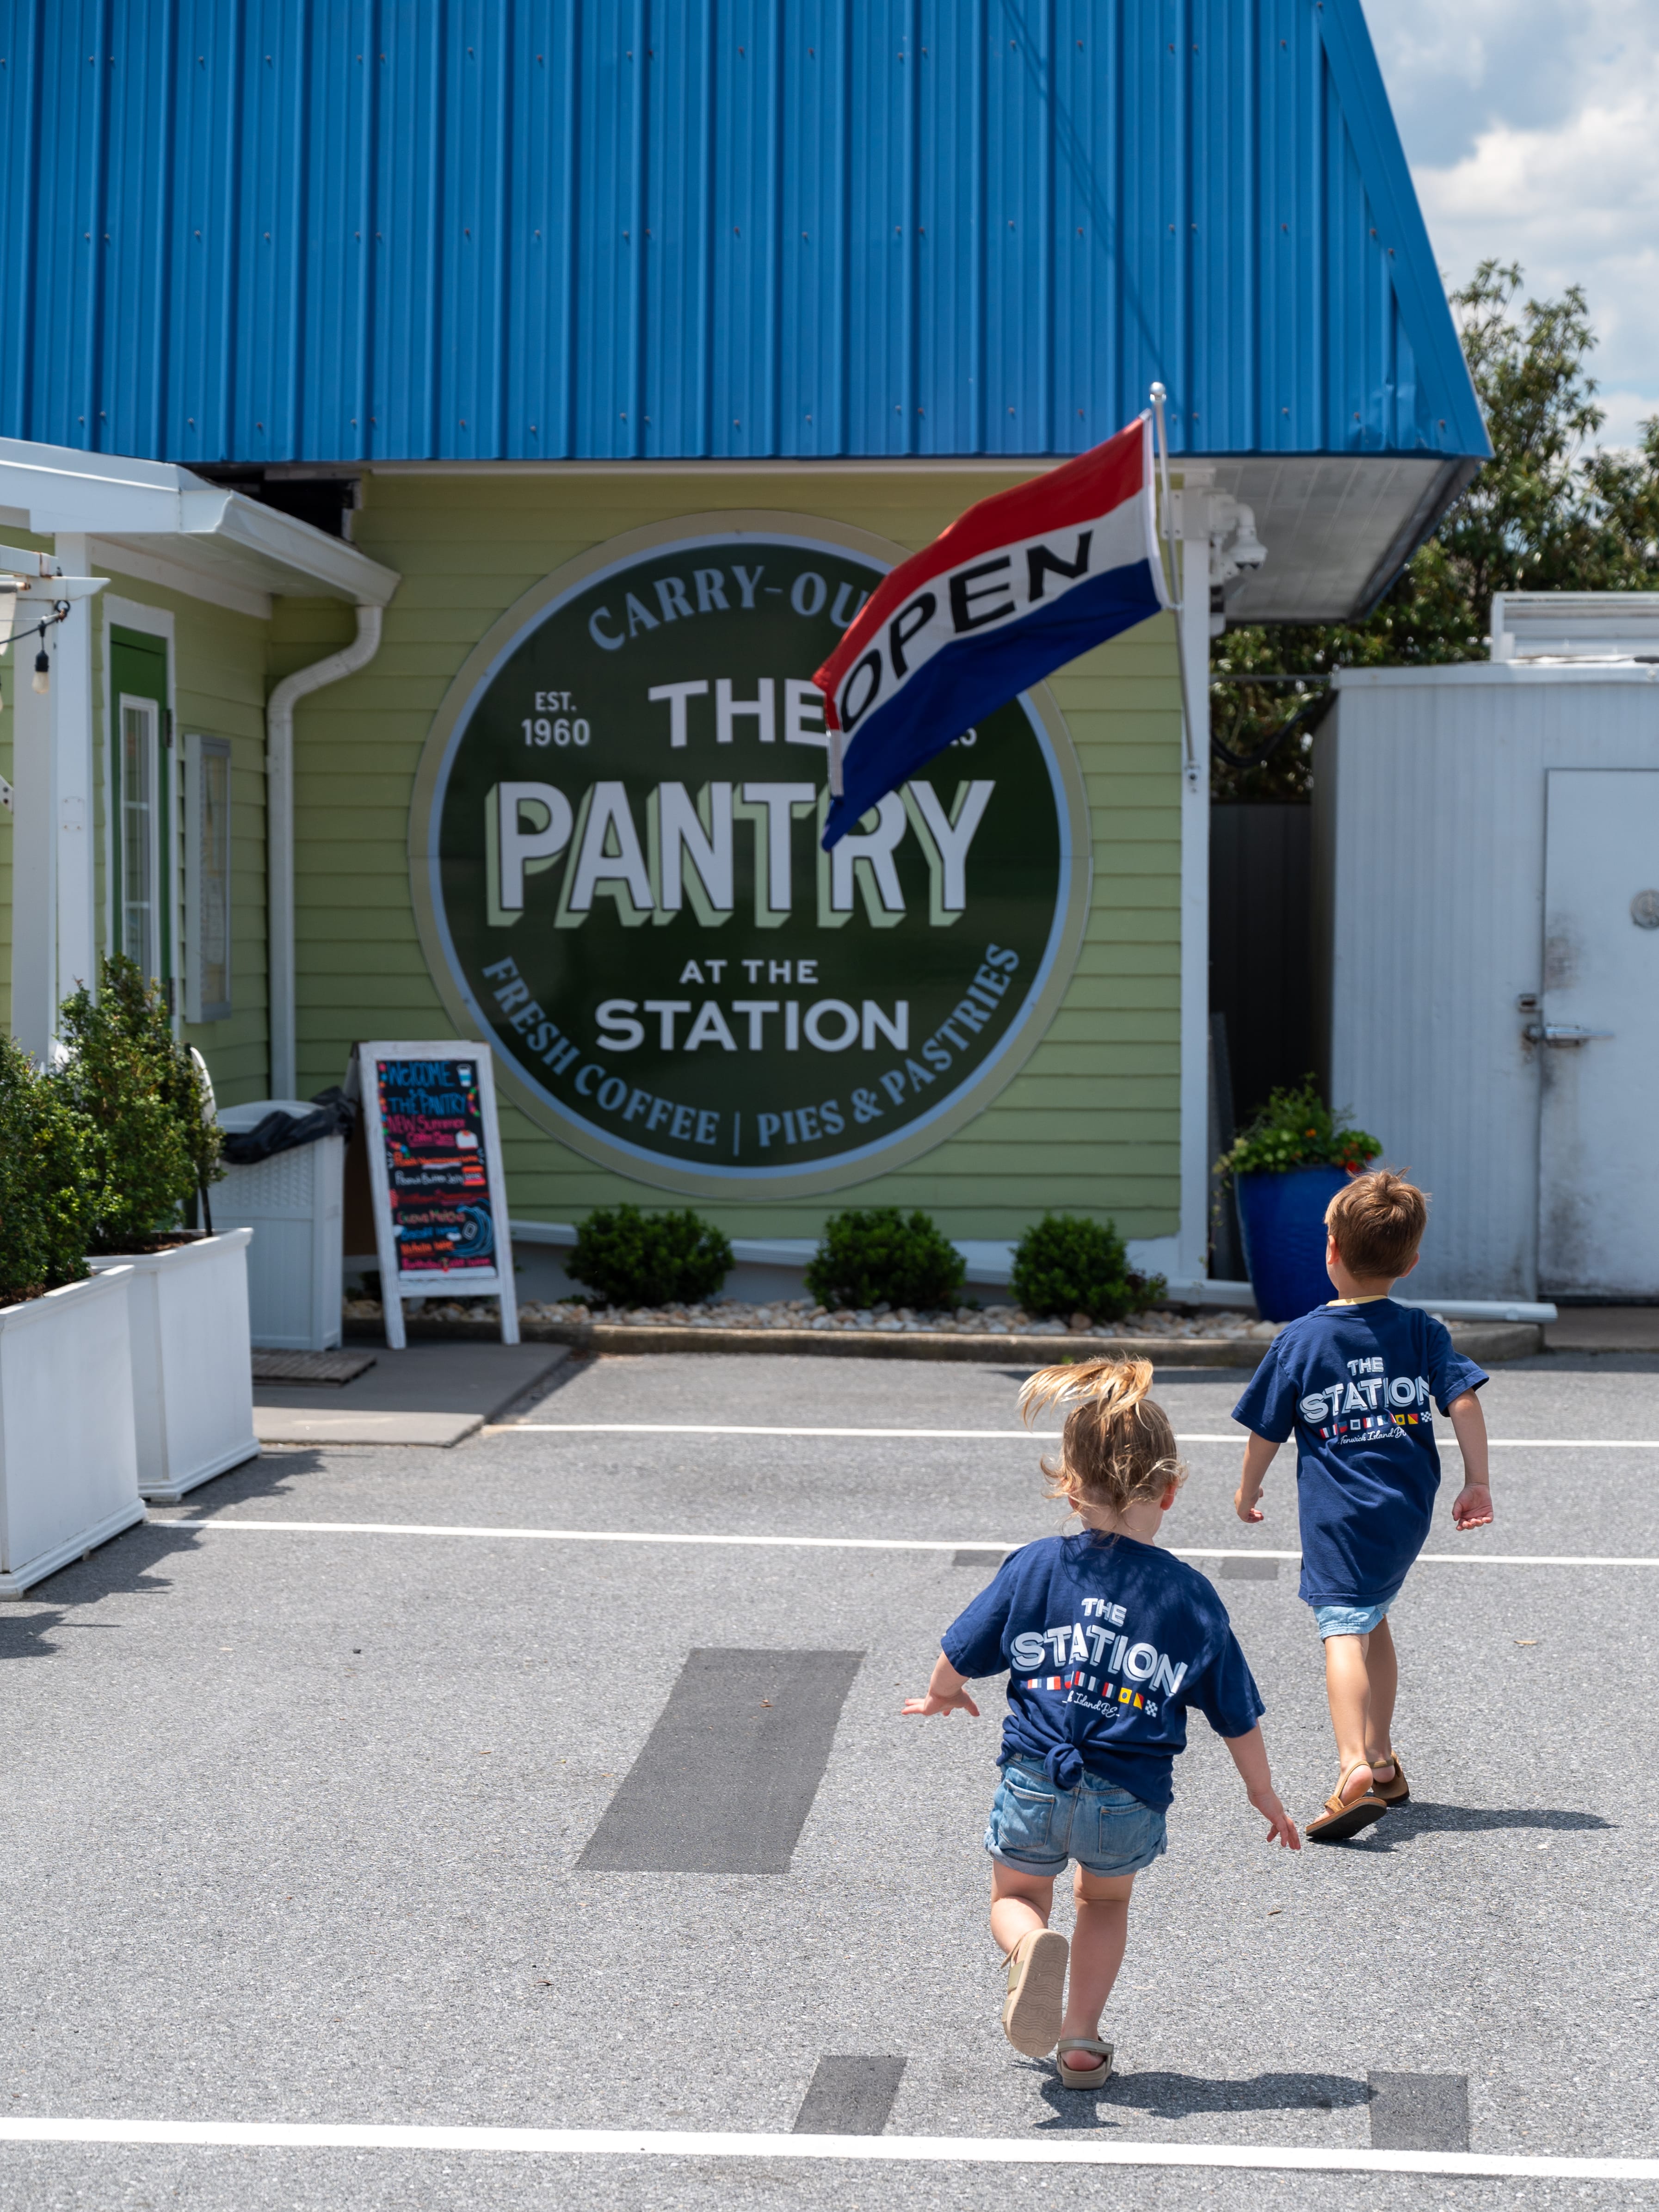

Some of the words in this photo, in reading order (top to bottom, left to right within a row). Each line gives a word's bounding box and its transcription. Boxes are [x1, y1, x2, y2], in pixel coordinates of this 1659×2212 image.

[588, 565, 871, 650] CARRY-OU
[839, 529, 1093, 733] OPEN
[534, 691, 577, 713] EST.
[648, 677, 829, 748] THE
[521, 718, 591, 747] 1960
[484, 780, 996, 928] PANTRY
[678, 959, 728, 984] AT
[741, 959, 819, 984] THE
[482, 955, 581, 1076] FRESH
[574, 1063, 721, 1146] COFFEE
[594, 998, 909, 1053] STATION
[756, 1099, 845, 1147] PIES
[850, 1087, 885, 1124] &
[879, 943, 1020, 1106] PASTRIES
[1347, 1356, 1385, 1376] THE
[1300, 1375, 1431, 1423] STATION
[1081, 1597, 1127, 1627] THE
[1010, 1622, 1188, 1697] STATION
[1101, 1702, 1118, 1718] DE
